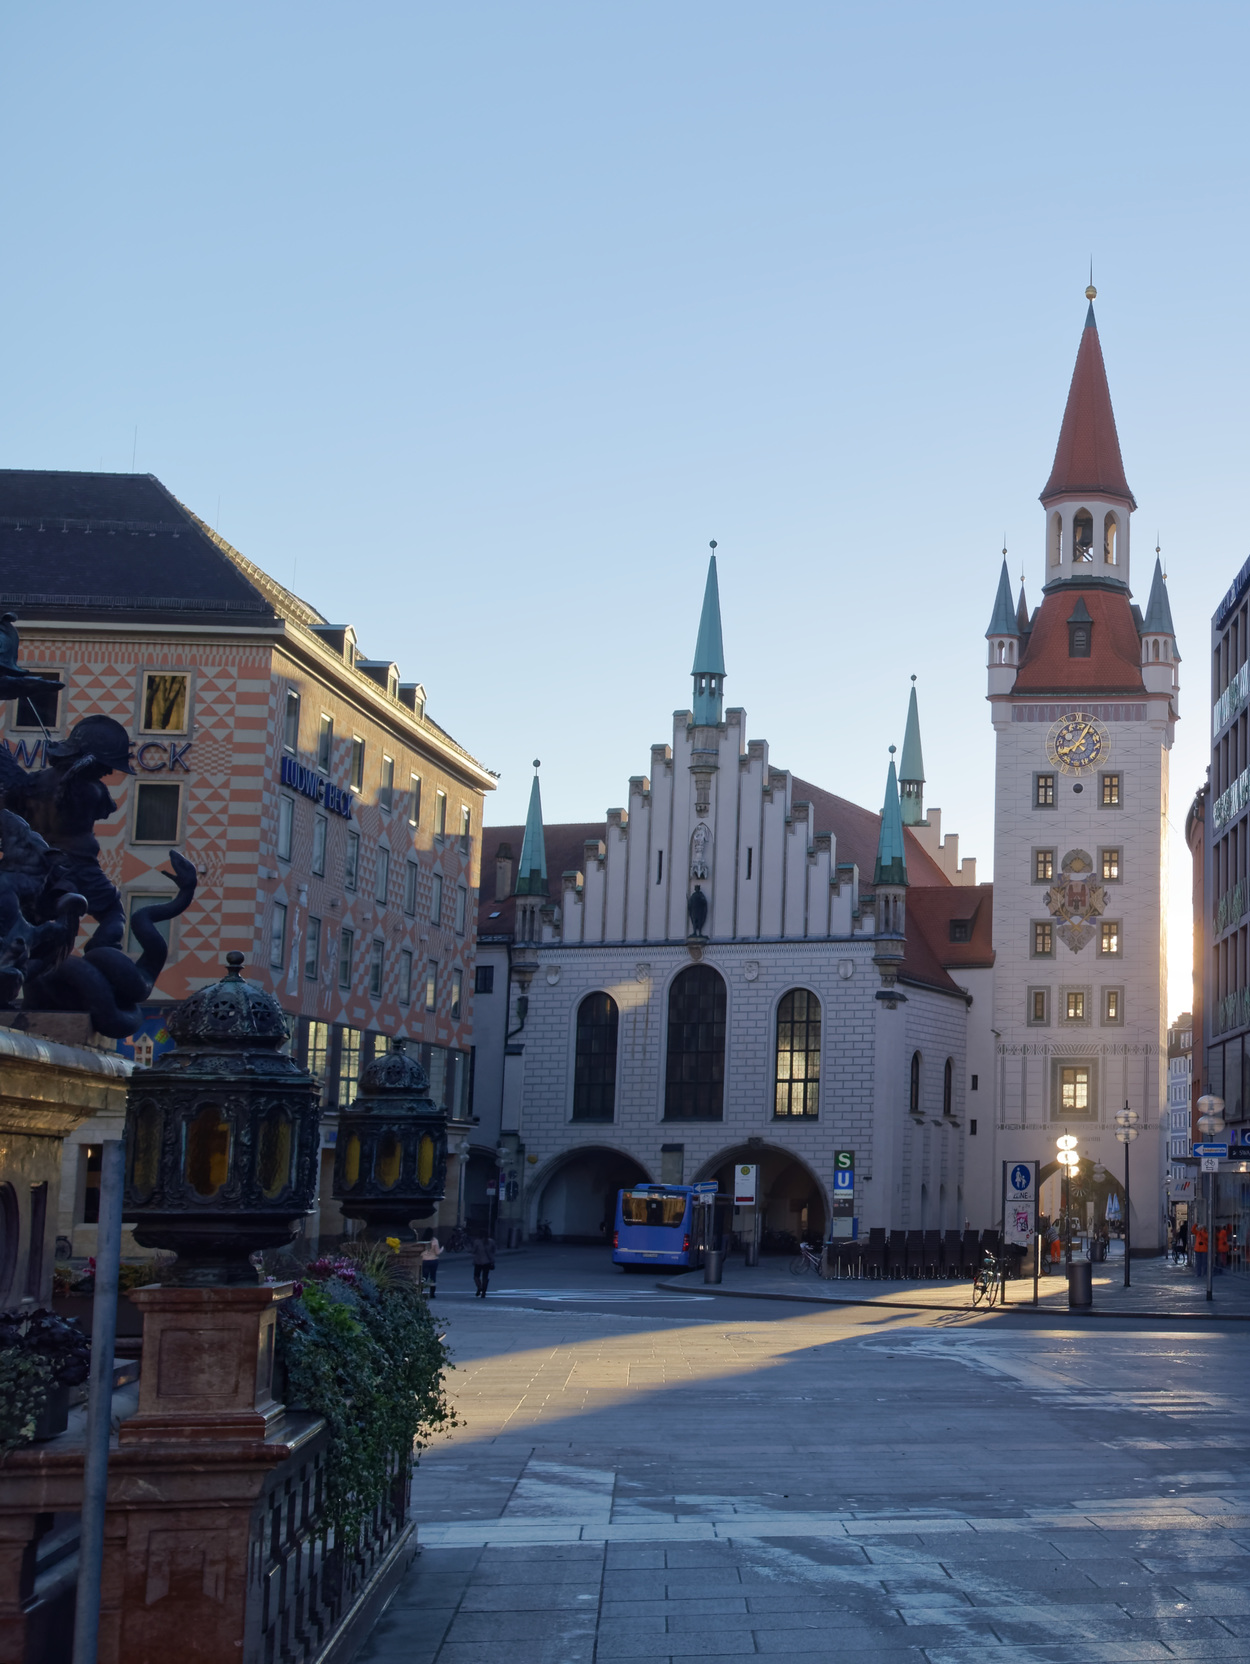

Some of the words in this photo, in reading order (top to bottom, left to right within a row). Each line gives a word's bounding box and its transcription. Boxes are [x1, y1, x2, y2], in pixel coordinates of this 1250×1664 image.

[285, 757, 325, 804] LUDWIG
[328, 784, 354, 816] BECK
[838, 1152, 851, 1168] S
[837, 1172, 850, 1187] U
